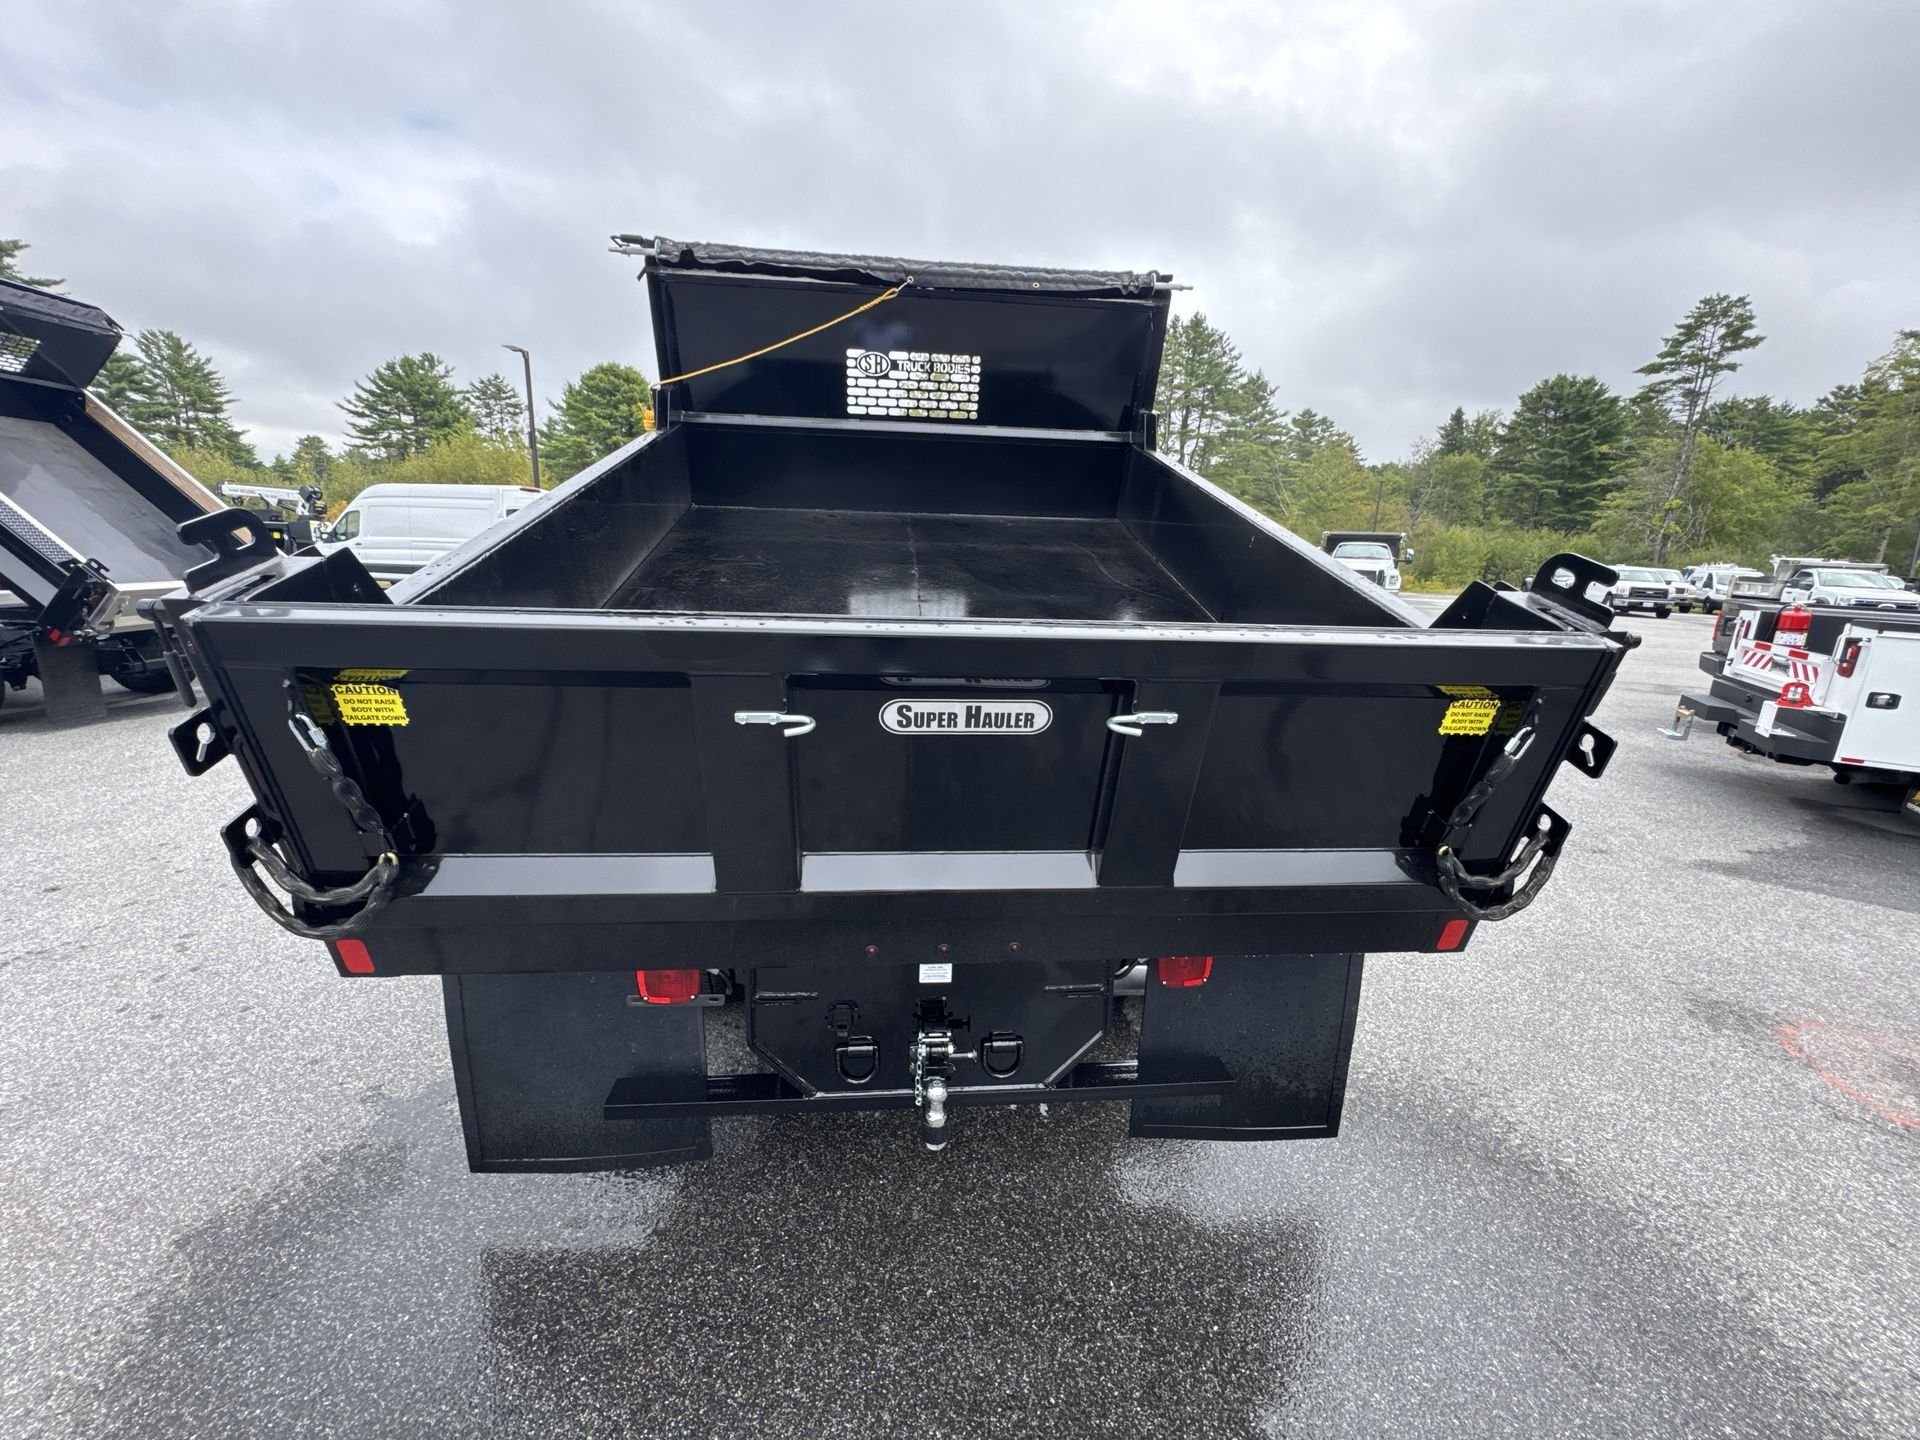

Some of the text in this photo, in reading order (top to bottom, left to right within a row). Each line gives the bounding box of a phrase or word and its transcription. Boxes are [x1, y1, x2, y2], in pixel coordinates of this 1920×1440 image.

[862, 354, 884, 374] SH
[897, 360, 971, 374] TRUCK BODIES
[334, 685, 398, 695] CAUTION
[1451, 701, 1498, 709] CAUTION
[896, 704, 1035, 729] SUPER HAULER
